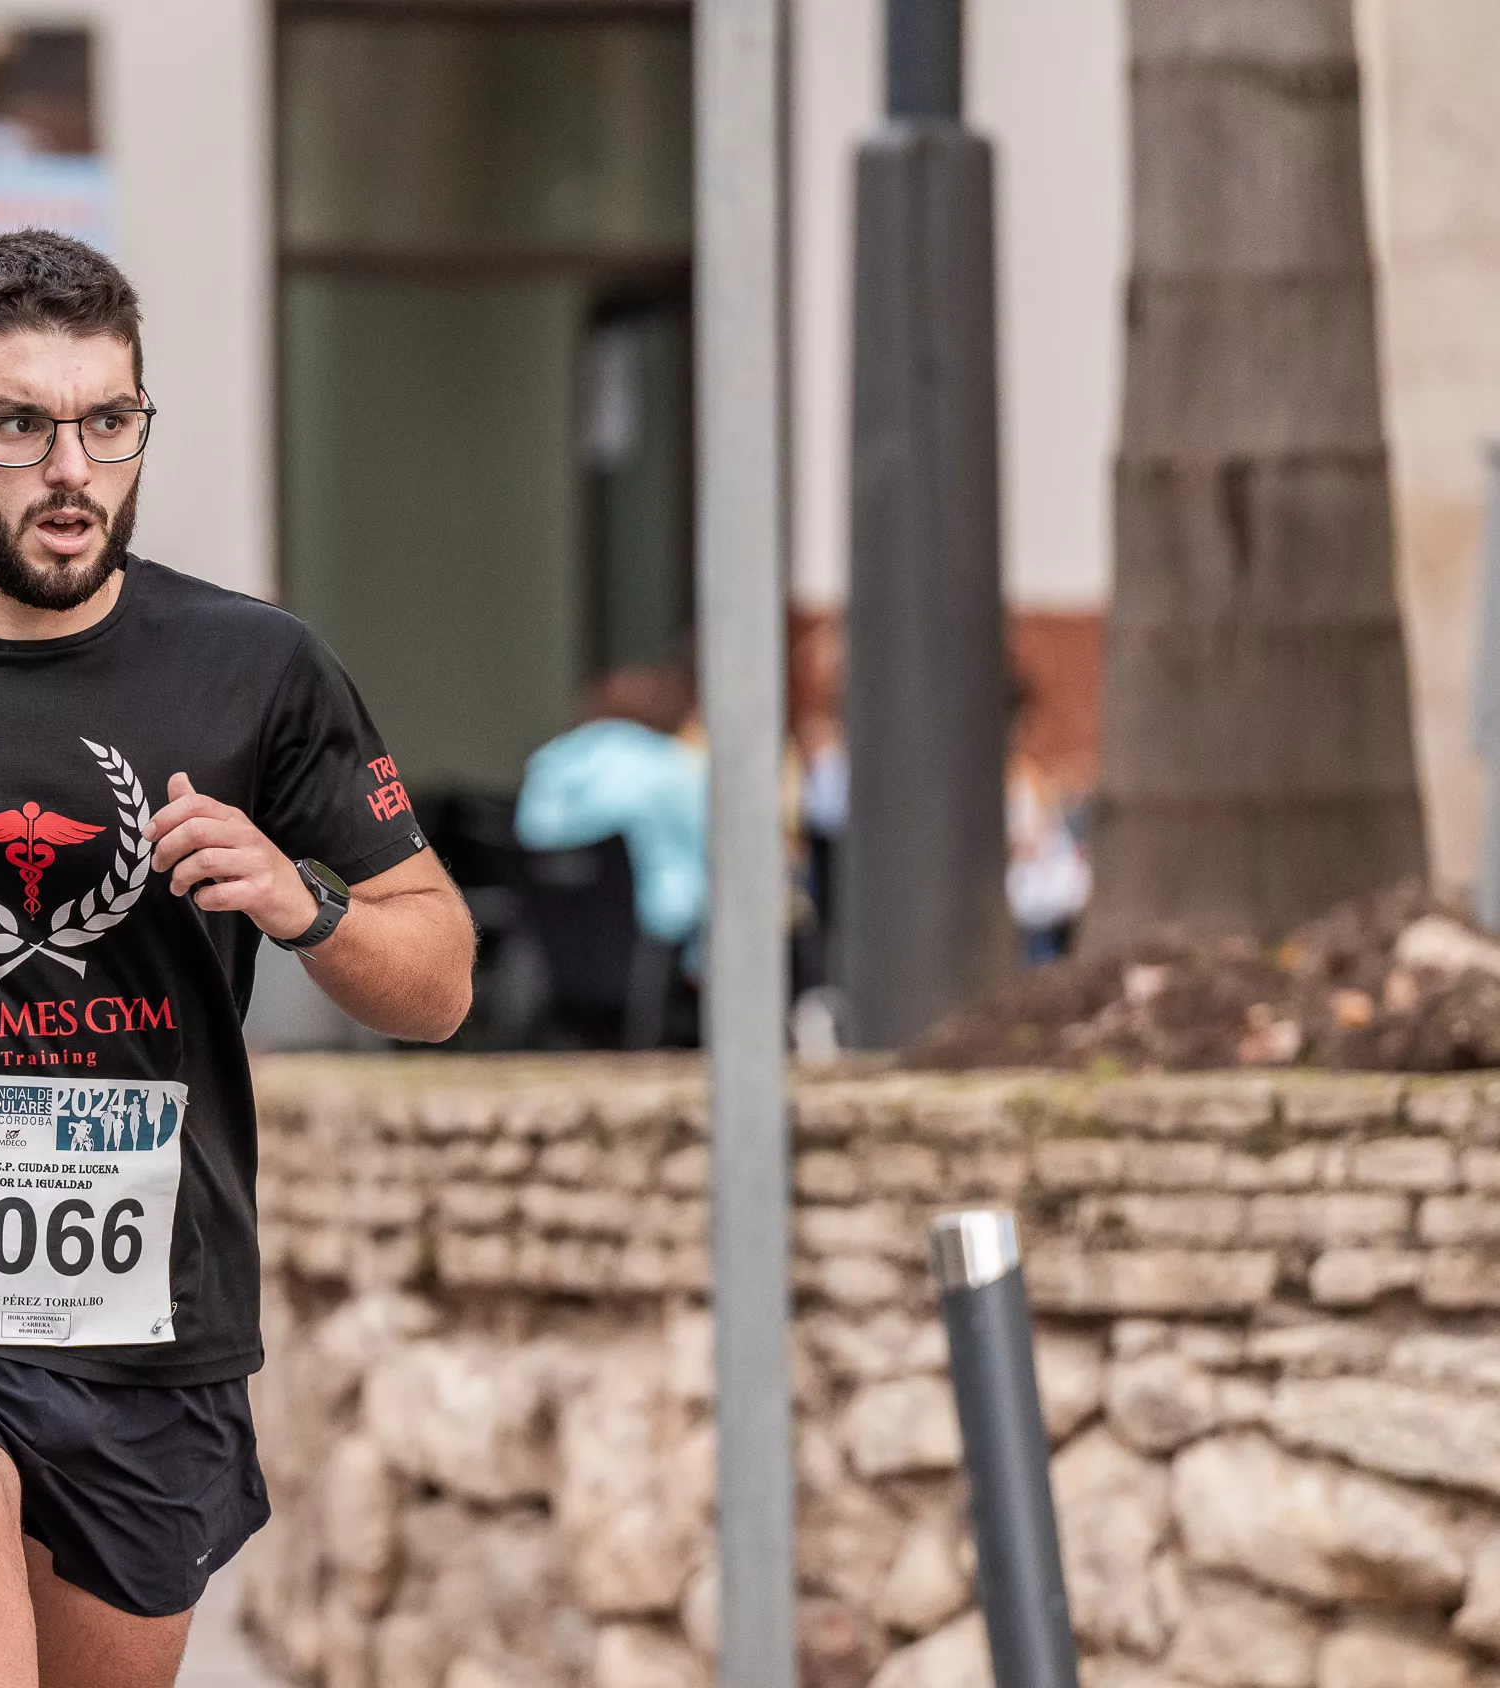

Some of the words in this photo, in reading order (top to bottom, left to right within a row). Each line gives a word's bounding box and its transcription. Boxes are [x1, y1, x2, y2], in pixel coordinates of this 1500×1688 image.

[366, 781, 412, 821] HER
[84, 996, 177, 1034] GYM
[0, 1049, 97, 1067] Training
[37, 1088, 52, 1101] DE
[57, 1088, 127, 1118] 2024
[18, 1162, 59, 1173] CIUDAD
[62, 1164, 77, 1174] DE
[79, 1164, 120, 1174] LUCENA
[17, 1178, 33, 1188] LA
[35, 1179, 93, 1190] IGUALDAD
[2, 1294, 42, 1307] PÉREZ
[44, 1296, 104, 1308] TORRALBO
